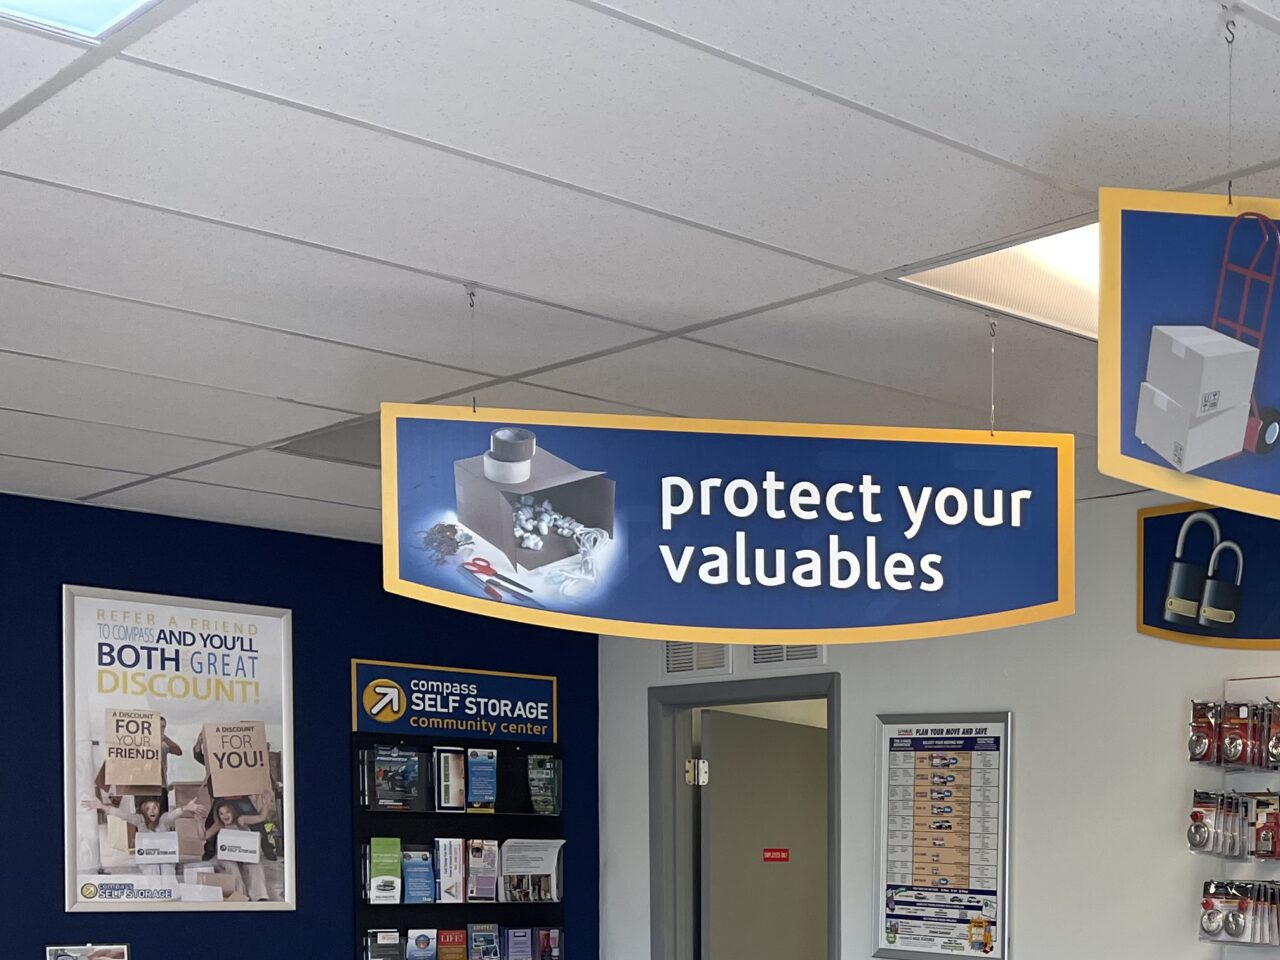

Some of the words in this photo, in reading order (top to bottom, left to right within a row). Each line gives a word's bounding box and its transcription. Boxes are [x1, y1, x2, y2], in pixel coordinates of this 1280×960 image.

[661, 471, 882, 530] protect
[898, 482, 1032, 540] your
[659, 533, 944, 592] valuables
[97, 609, 155, 625] REFER
[168, 616, 178, 627] A
[190, 618, 258, 636] FRIEND
[97, 623, 110, 639] TO
[111, 624, 155, 643] COMPASS
[156, 629, 196, 646] AND
[199, 632, 259, 653] YOU'LL
[97, 642, 180, 672] BOTH
[190, 651, 259, 679] GREAT
[97, 669, 260, 704] DISCOUNT!
[410, 679, 477, 696] compass
[411, 692, 460, 713] SELF
[465, 697, 549, 720] STORAGE
[115, 719, 152, 735] FOR
[409, 716, 497, 735] community
[500, 721, 548, 735] center
[930, 728, 944, 736] YOUR
[945, 728, 960, 736] MOVE
[974, 727, 988, 735] SAVE
[116, 735, 150, 747] YOUR
[221, 734, 253, 749] FOR
[108, 747, 159, 760] FRIEND!
[213, 751, 264, 768] YOU!
[98, 889, 128, 899] SELF
[127, 889, 172, 899] STORAGE
